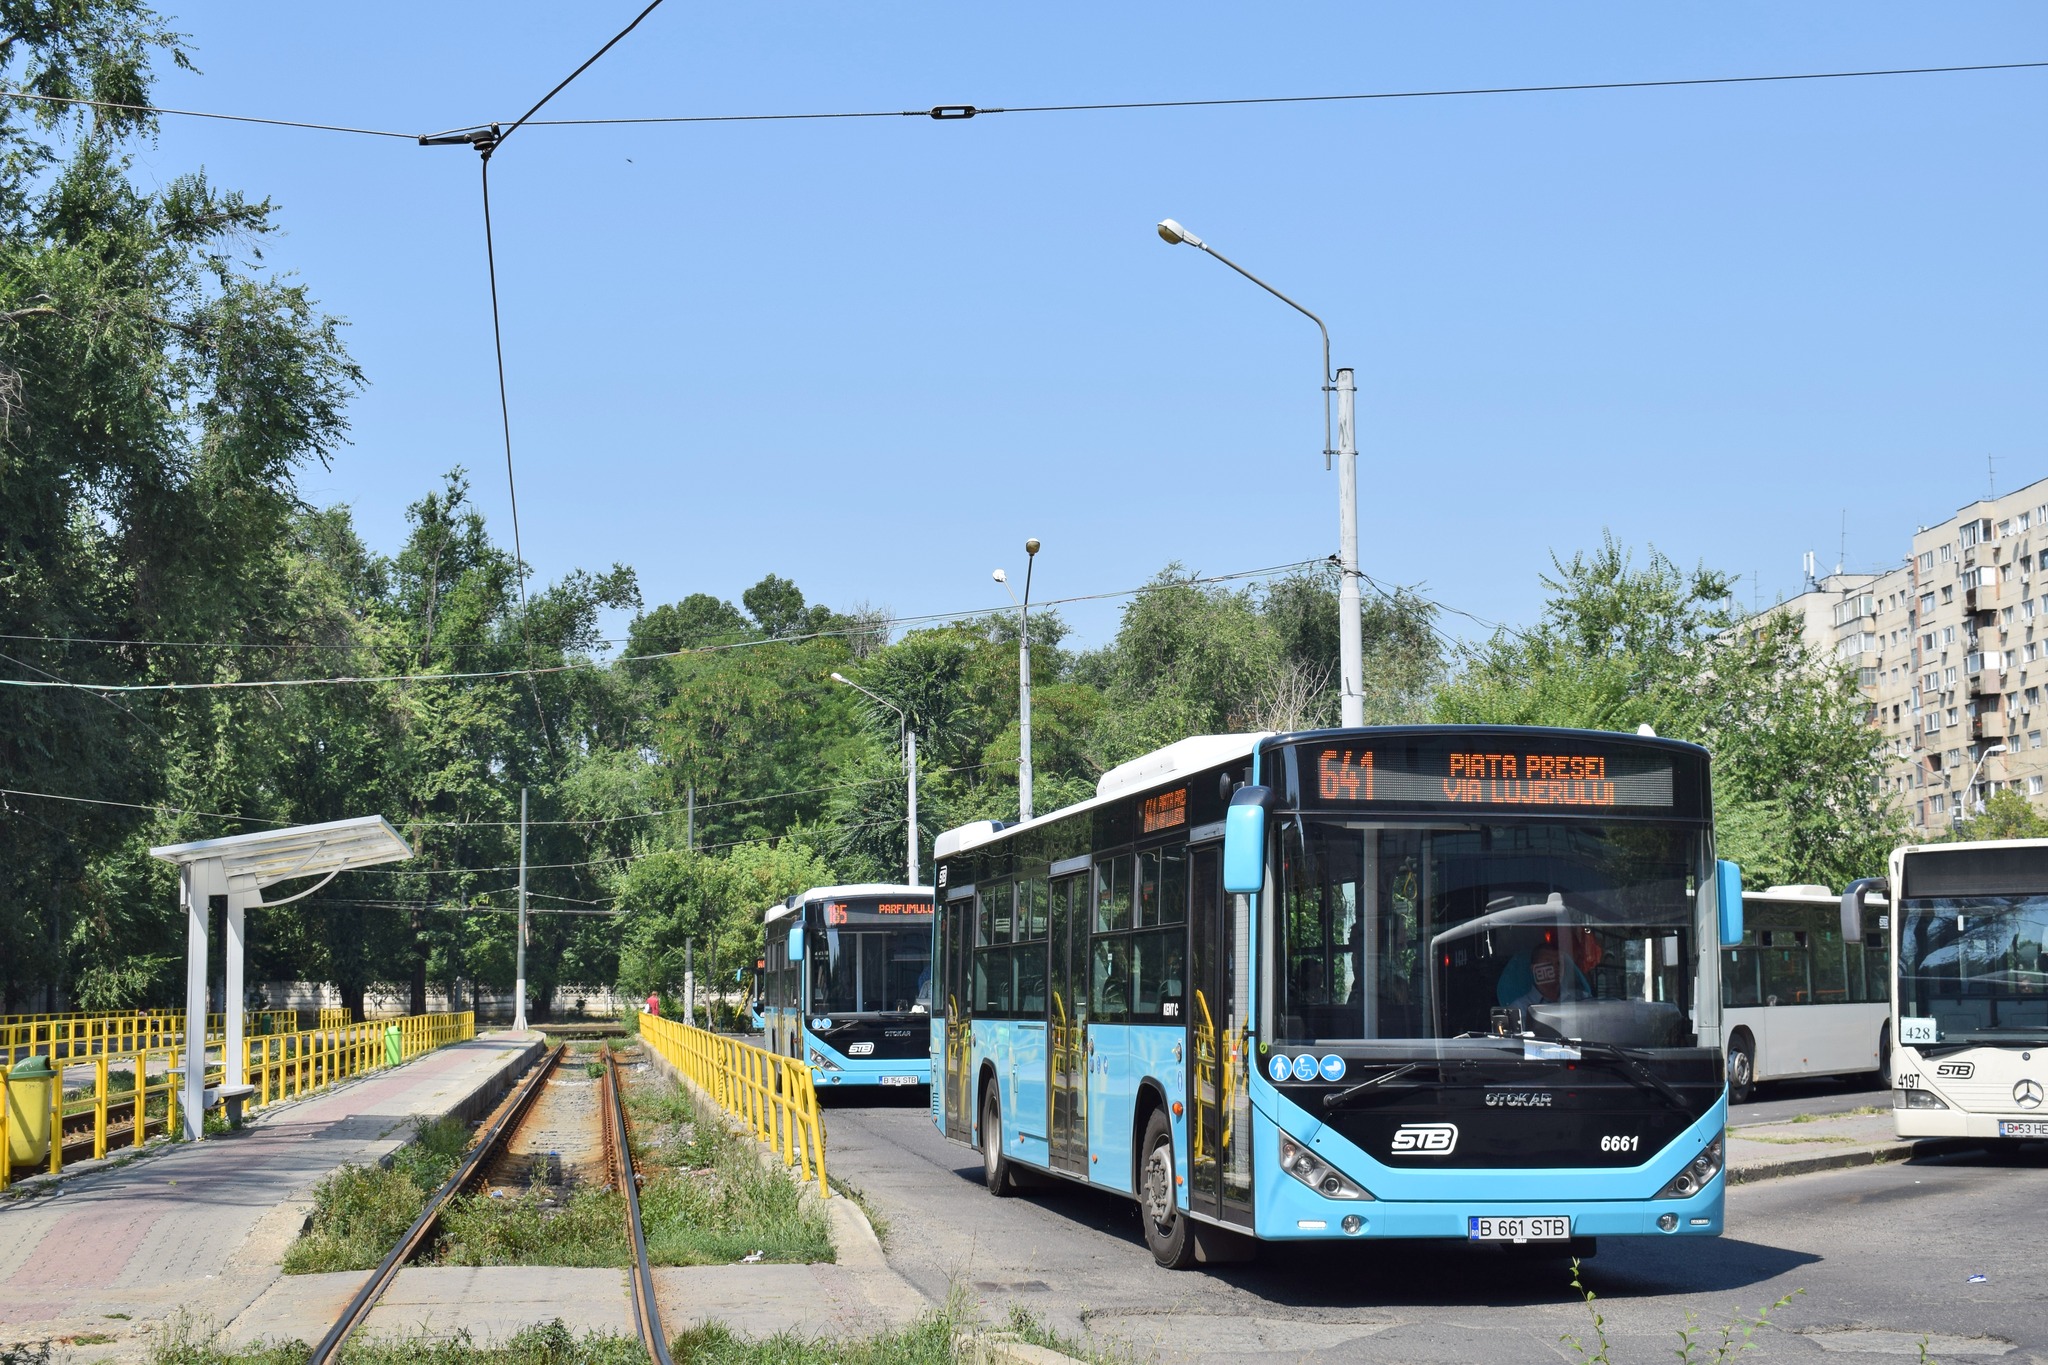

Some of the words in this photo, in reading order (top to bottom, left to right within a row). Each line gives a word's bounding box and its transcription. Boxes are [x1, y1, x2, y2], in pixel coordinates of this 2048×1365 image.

[1450, 753, 1517, 778] PIATA
[1526, 755, 1605, 780] PRESEI
[1320, 750, 1373, 800] 641
[1443, 778, 1482, 802] VIA
[1491, 779, 1614, 805] LUJERULUI
[827, 904, 848, 925] 185
[1905, 1027, 1931, 1040] 428
[849, 1043, 873, 1053] STB
[1937, 1064, 1972, 1077] STB
[902, 1076, 917, 1084] STB
[1898, 1073, 1920, 1089] 4197
[1485, 1093, 1552, 1107] OTOKAR
[2007, 1124, 2015, 1134] B
[2018, 1124, 2031, 1134] 53
[1391, 1127, 1453, 1151] STB
[1600, 1135, 1639, 1151] 6661
[1480, 1220, 1492, 1237] B
[1498, 1219, 1525, 1237] 661
[1531, 1219, 1565, 1237] STB
